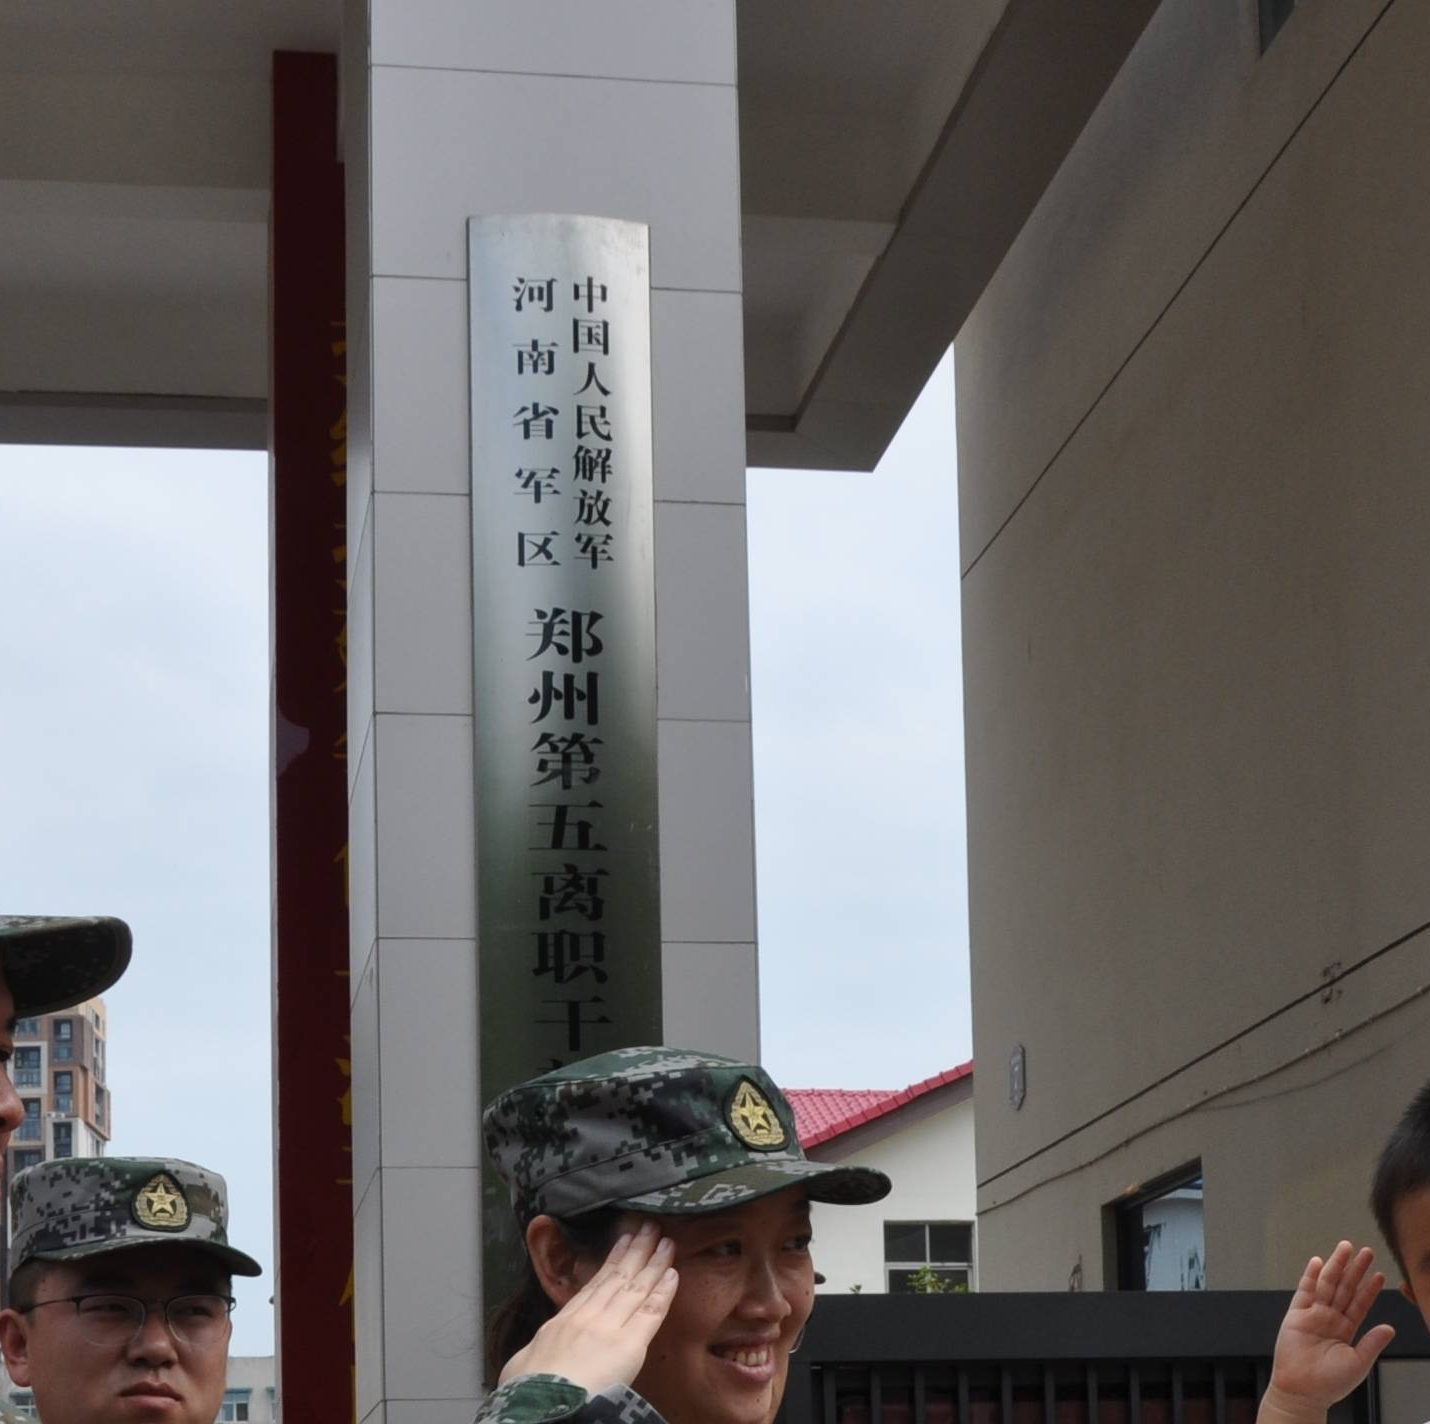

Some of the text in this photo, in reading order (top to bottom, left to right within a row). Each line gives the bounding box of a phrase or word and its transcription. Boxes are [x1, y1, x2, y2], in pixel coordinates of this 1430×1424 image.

[512, 275, 561, 569] 河南省军区
[572, 275, 614, 570] 中国人民解放军
[525, 606, 613, 1070] 郑州第五离职干
